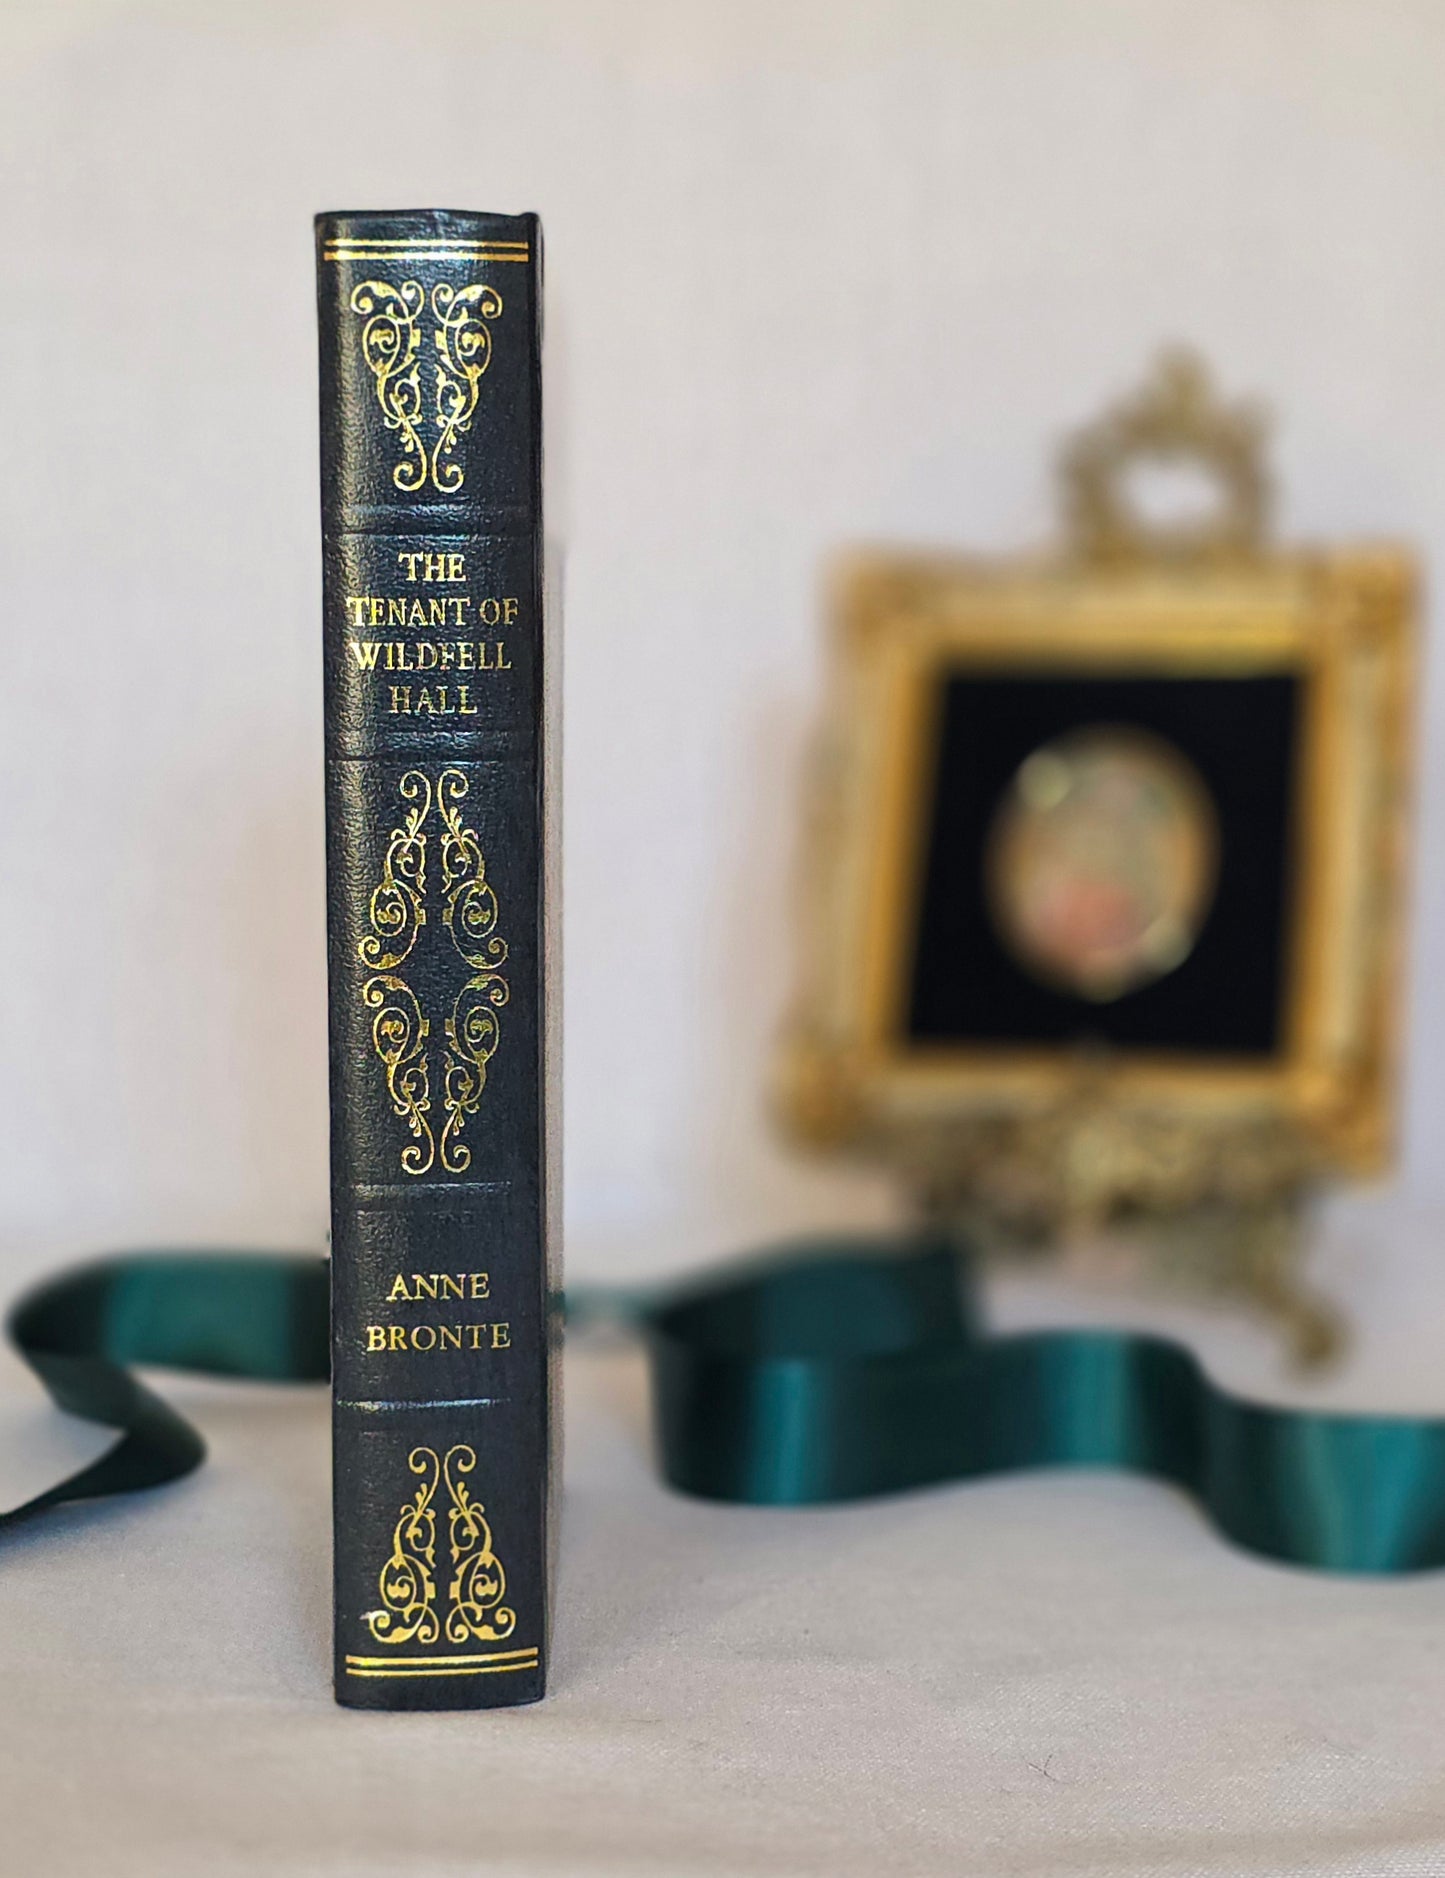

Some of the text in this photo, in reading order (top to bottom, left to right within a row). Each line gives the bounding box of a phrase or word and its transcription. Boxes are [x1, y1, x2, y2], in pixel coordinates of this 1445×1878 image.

[398, 553, 467, 582] THE
[347, 596, 519, 627] TENANT OF
[349, 641, 513, 671] WILDFELL
[388, 685, 478, 715] HALL
[385, 1272, 490, 1302] ANNE
[366, 1322, 511, 1352] BRONTE
